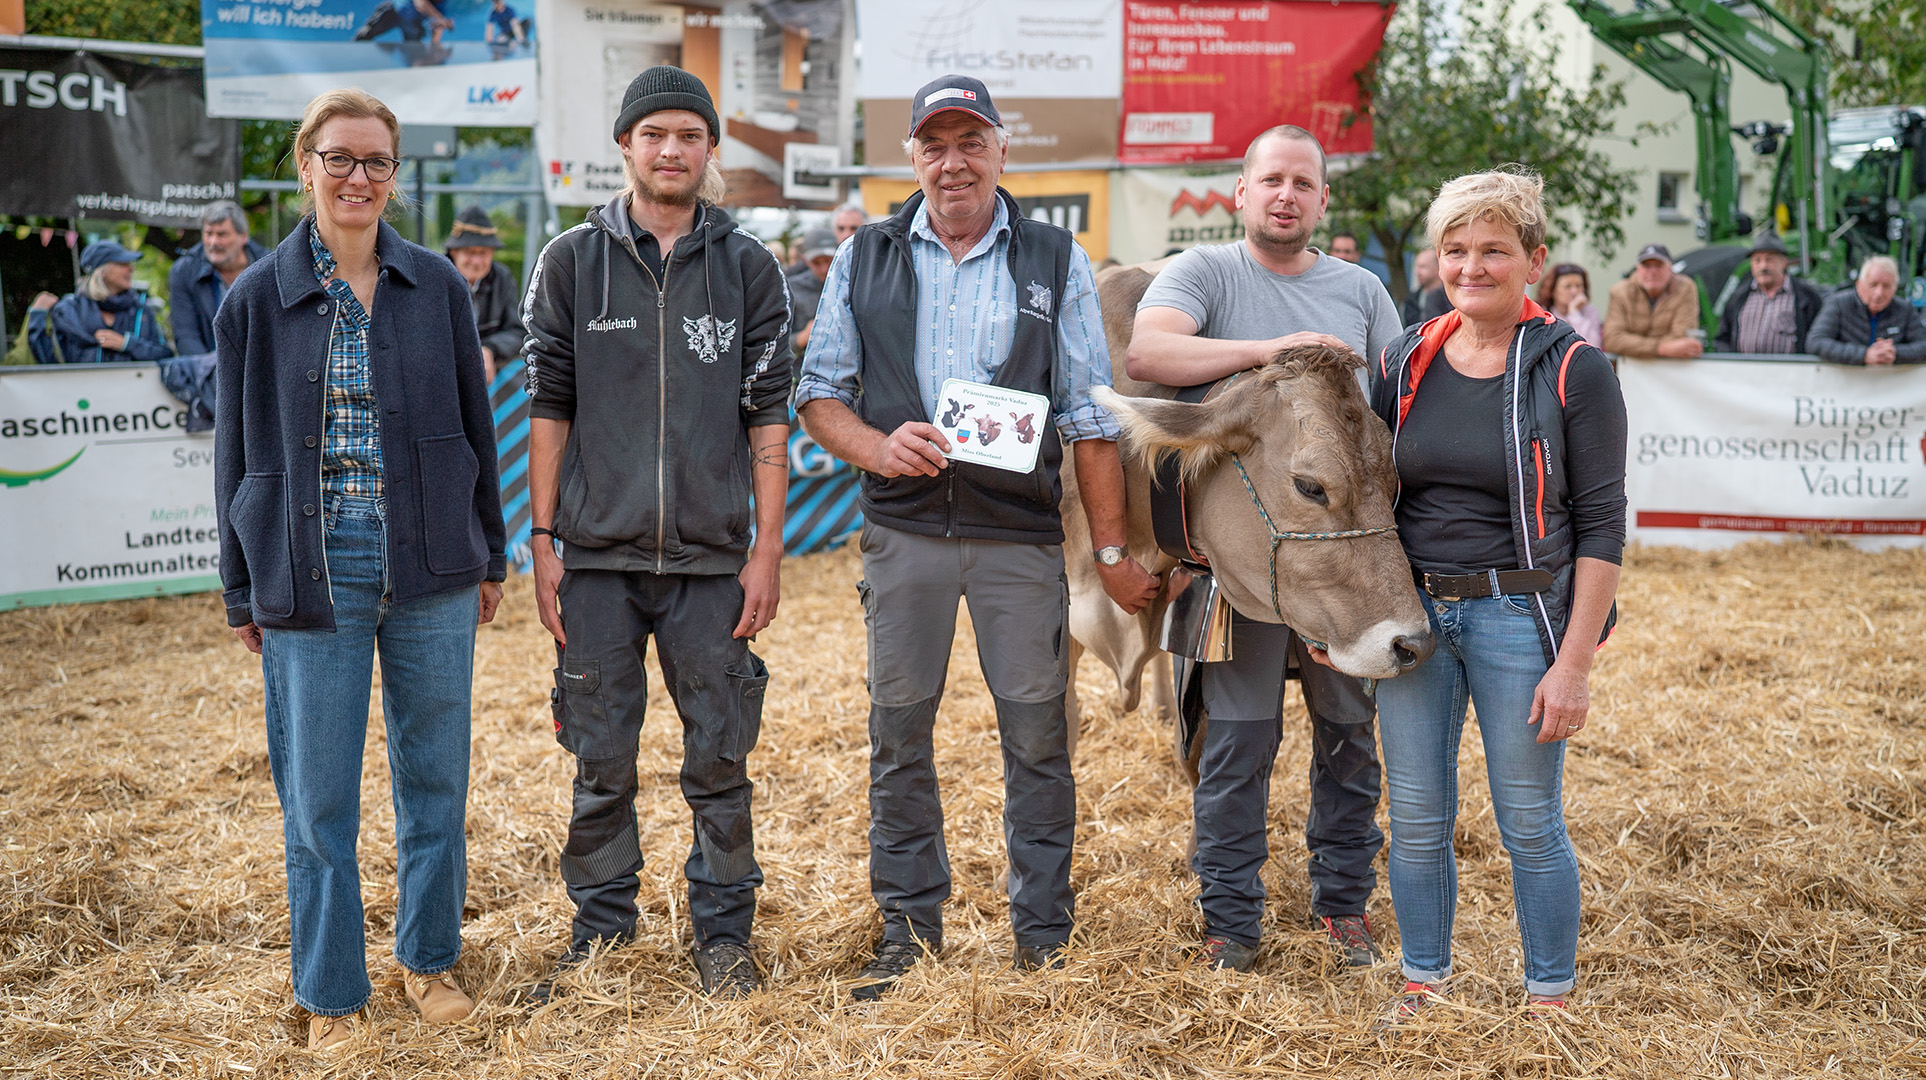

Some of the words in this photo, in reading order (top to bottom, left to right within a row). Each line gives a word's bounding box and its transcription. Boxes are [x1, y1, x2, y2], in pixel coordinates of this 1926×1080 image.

[217, 4, 250, 23] will
[252, 6, 283, 26] ich
[285, 9, 355, 30] haben!
[1129, 3, 1177, 21] Türen,
[1179, 4, 1236, 21] Fenster
[1238, 5, 1270, 21] und
[1128, 21, 1229, 38] Innenausbau.
[1128, 38, 1154, 54] Für
[1157, 38, 1197, 54] Ihren
[0, 69, 127, 117] TSCH
[162, 181, 236, 199] patsch.li
[1794, 395, 1926, 438] Bürger-
[1543, 438, 1552, 475] ORTOVOX
[1637, 432, 1911, 466] genossenschaft
[1799, 464, 1910, 500] Vaduz
[150, 507, 189, 523] Mein
[125, 526, 219, 550] Landtec
[57, 553, 219, 583] Kommunaltec
